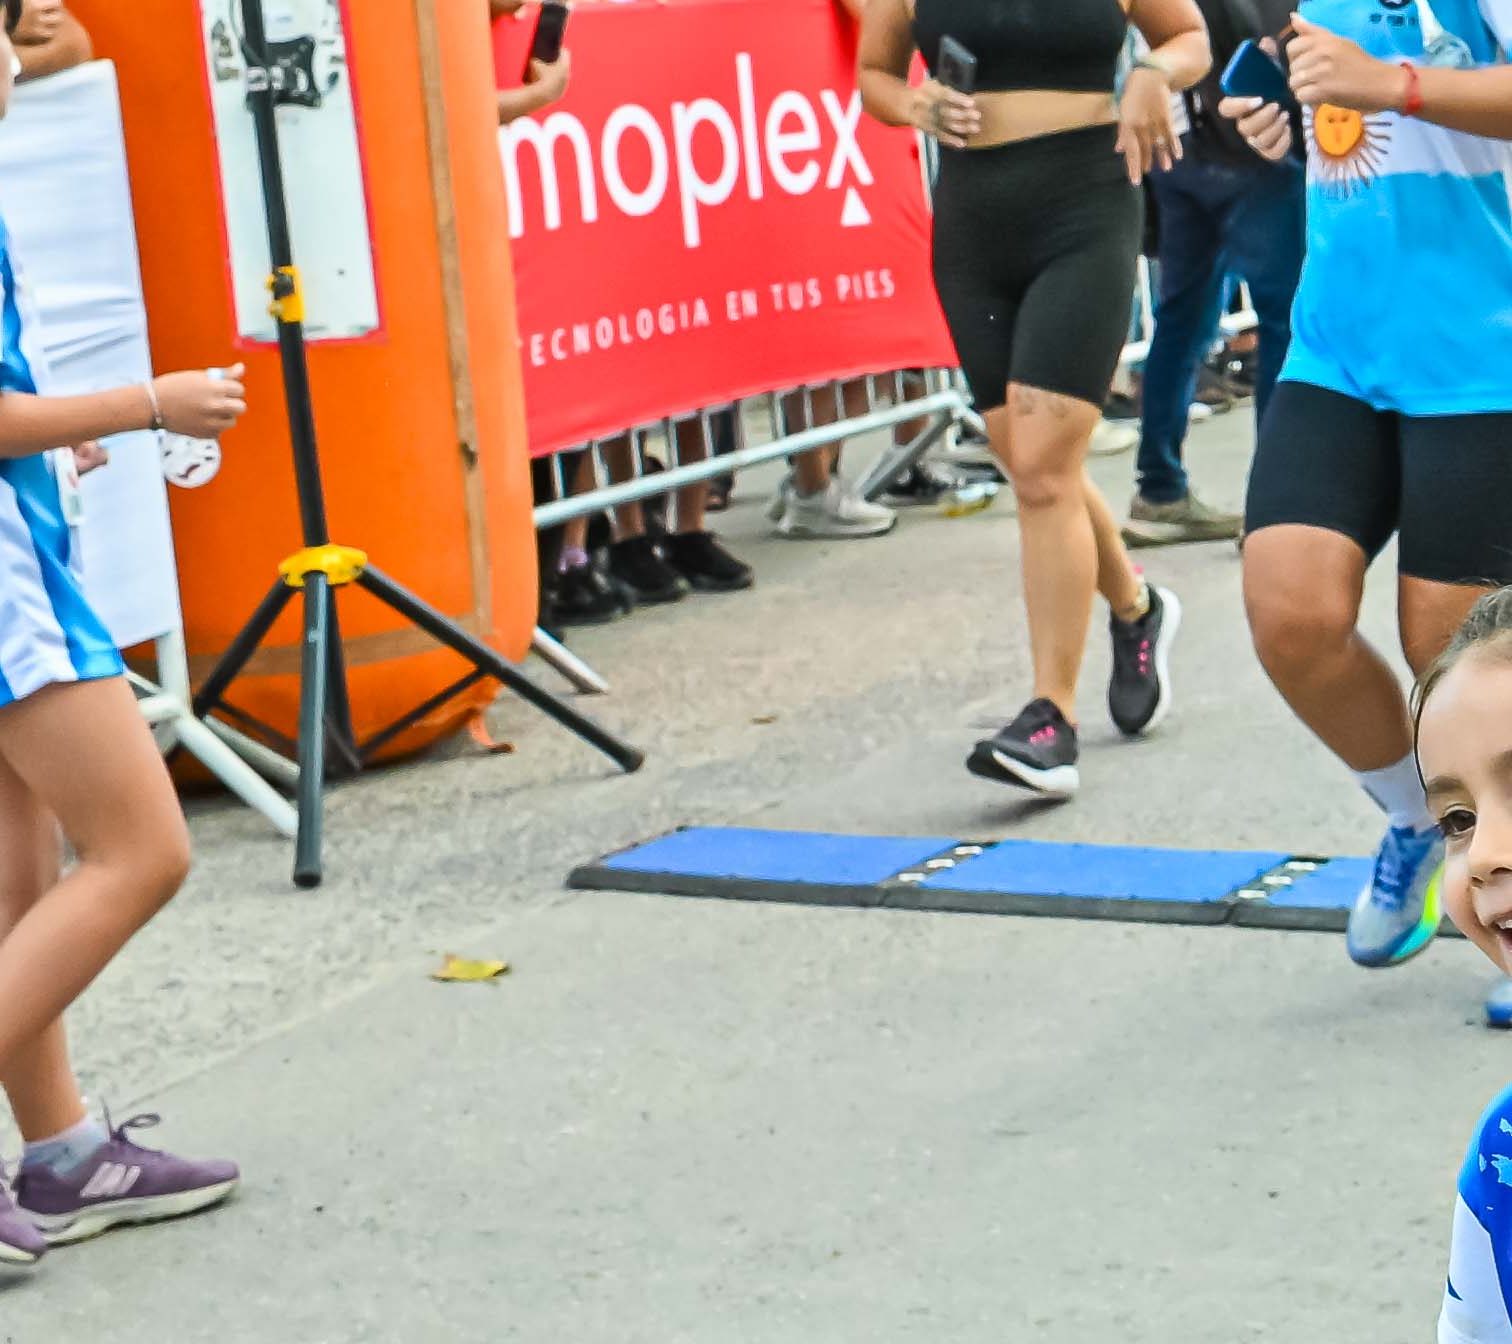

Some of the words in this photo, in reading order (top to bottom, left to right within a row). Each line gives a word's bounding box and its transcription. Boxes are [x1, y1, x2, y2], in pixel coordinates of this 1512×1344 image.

[500, 52, 874, 248] moplex
[517, 297, 711, 367] ECNOLOGIA
[726, 288, 759, 322] EN
[770, 277, 823, 312] TUS
[836, 268, 896, 303] PIES
